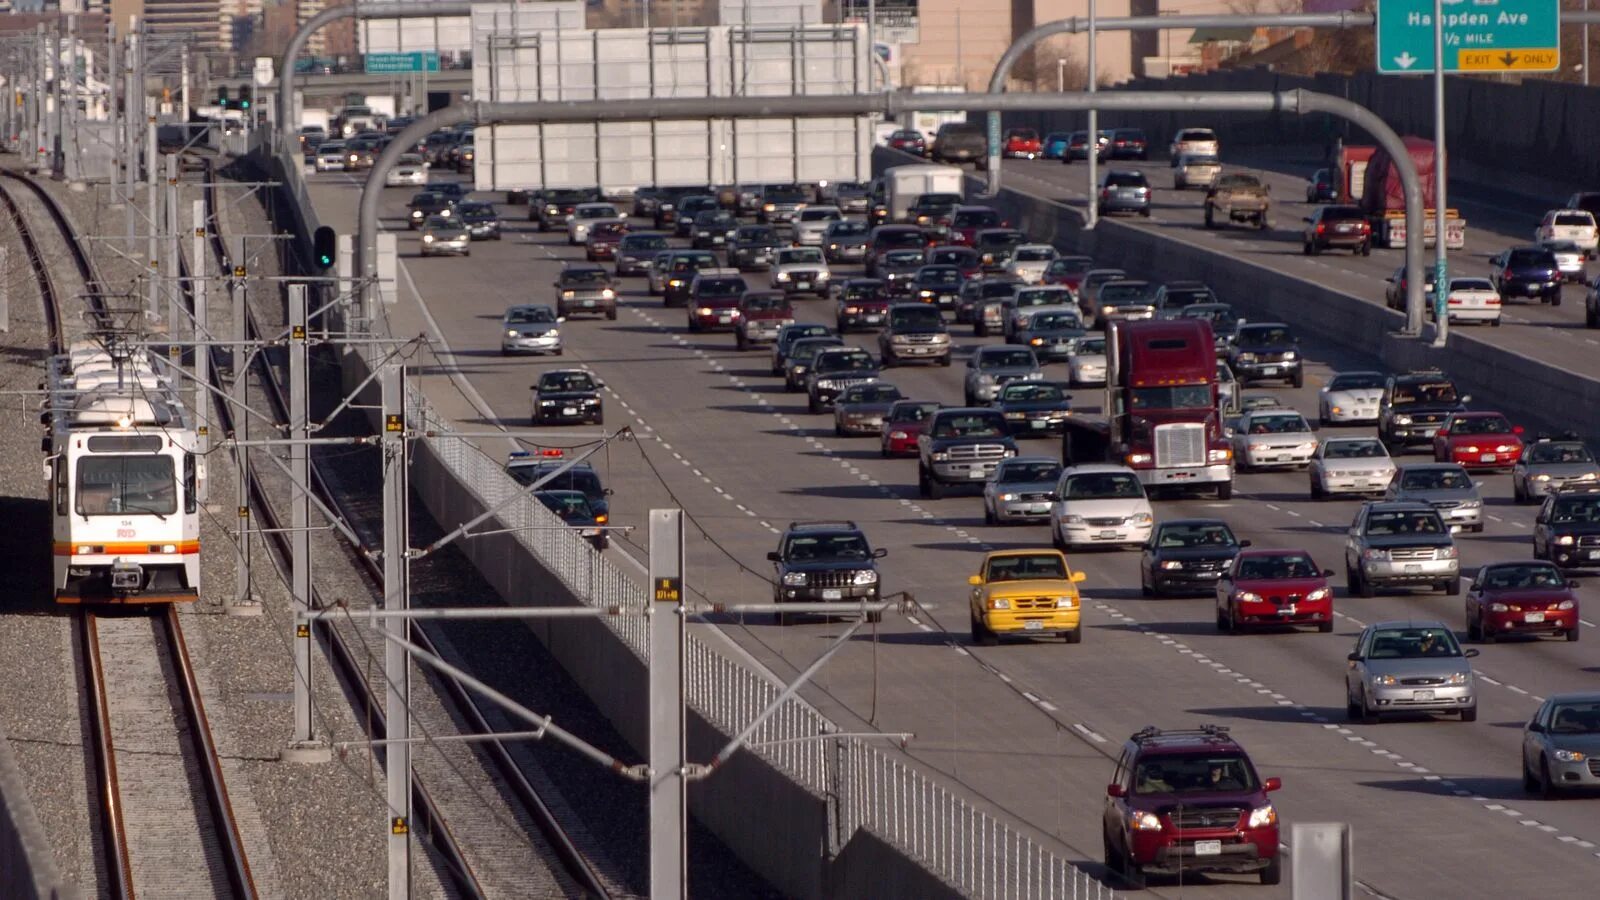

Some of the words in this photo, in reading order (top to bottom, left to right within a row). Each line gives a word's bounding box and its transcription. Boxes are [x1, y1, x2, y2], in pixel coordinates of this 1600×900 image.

[1498, 11, 1528, 24] Ave
[1466, 33, 1494, 43] MILE
[1466, 54, 1490, 64] EXIT
[1524, 53, 1553, 64] ONLY
